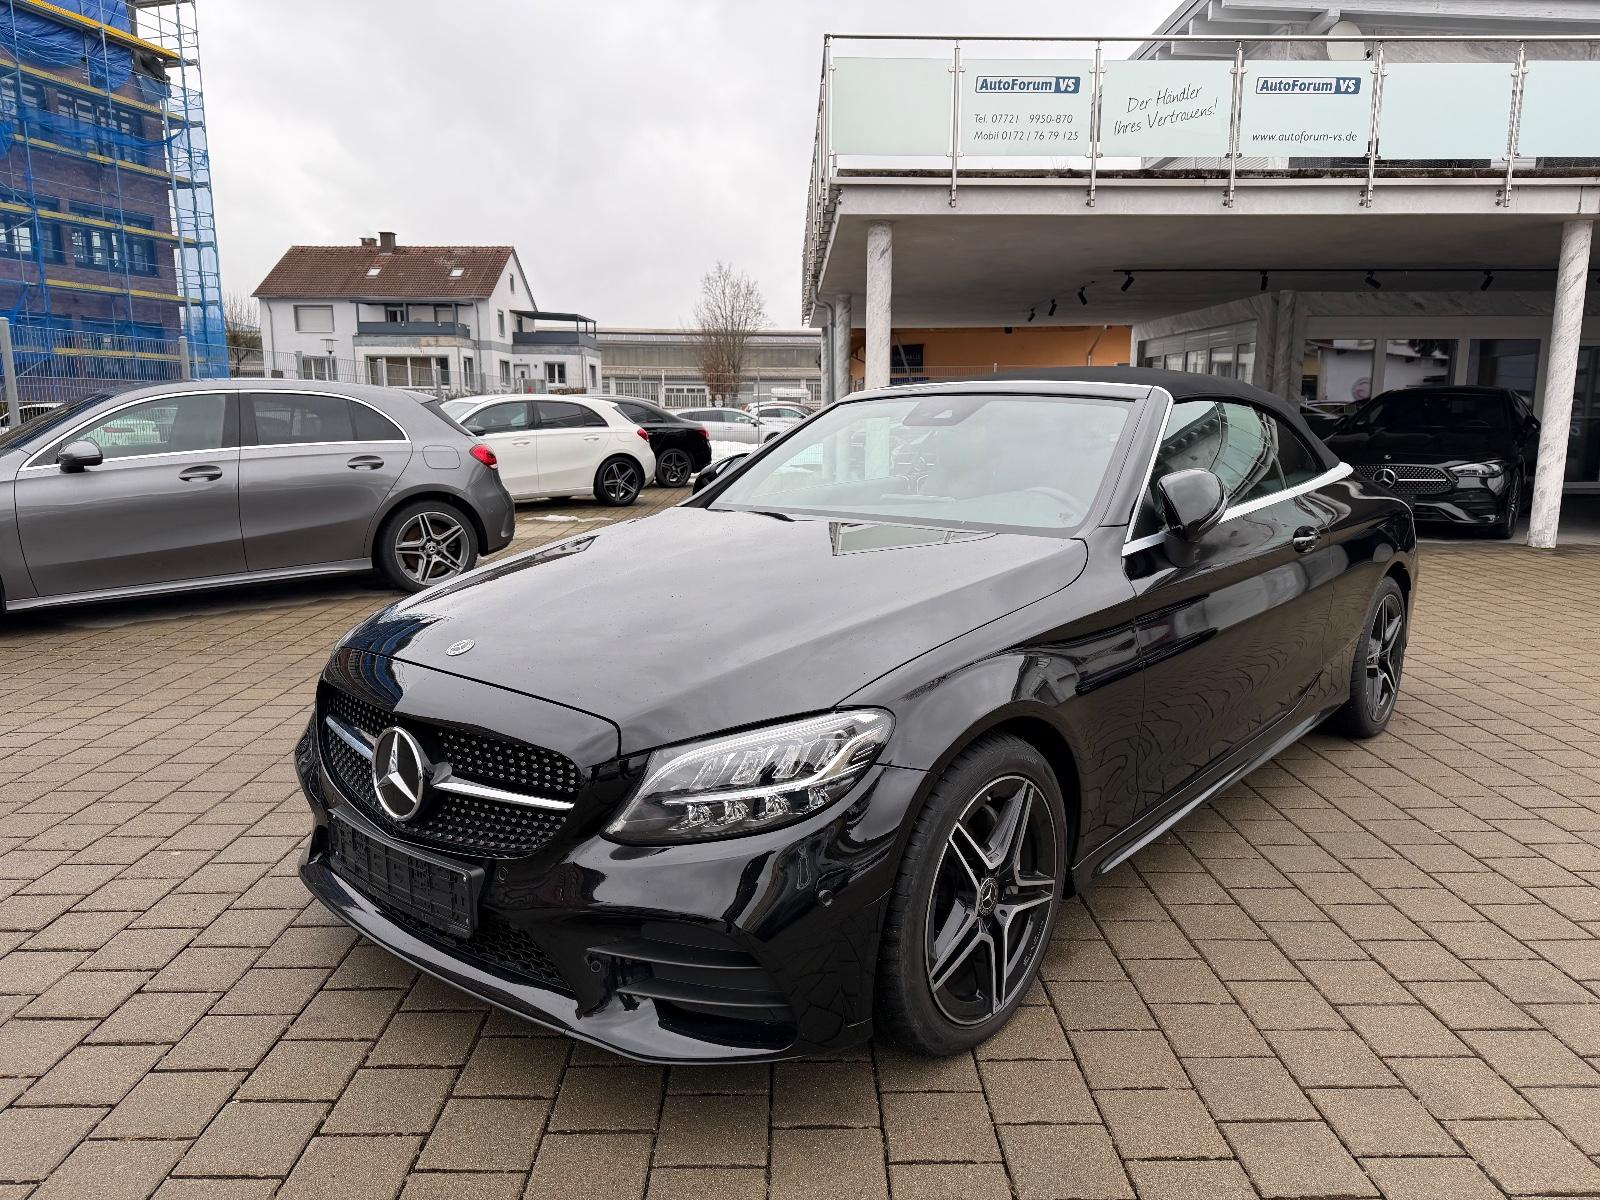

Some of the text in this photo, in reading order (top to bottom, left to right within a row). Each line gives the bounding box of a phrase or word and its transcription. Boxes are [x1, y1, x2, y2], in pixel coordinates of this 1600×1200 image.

[979, 78, 1076, 92] AutoForum VS
[1260, 79, 1356, 92] AutoForum VS
[1126, 83, 1202, 113] Der Händler
[974, 114, 1073, 124] Tel. 07721 9950-870
[1114, 96, 1219, 136] Ihres Vertrauens!
[974, 131, 999, 141] Mobil
[1001, 131, 1025, 141] 0172
[1034, 131, 1045, 141] 76
[1048, 131, 1059, 141] 79
[1063, 131, 1079, 141] 125
[1252, 131, 1358, 143] www.autoforum-vs.de
